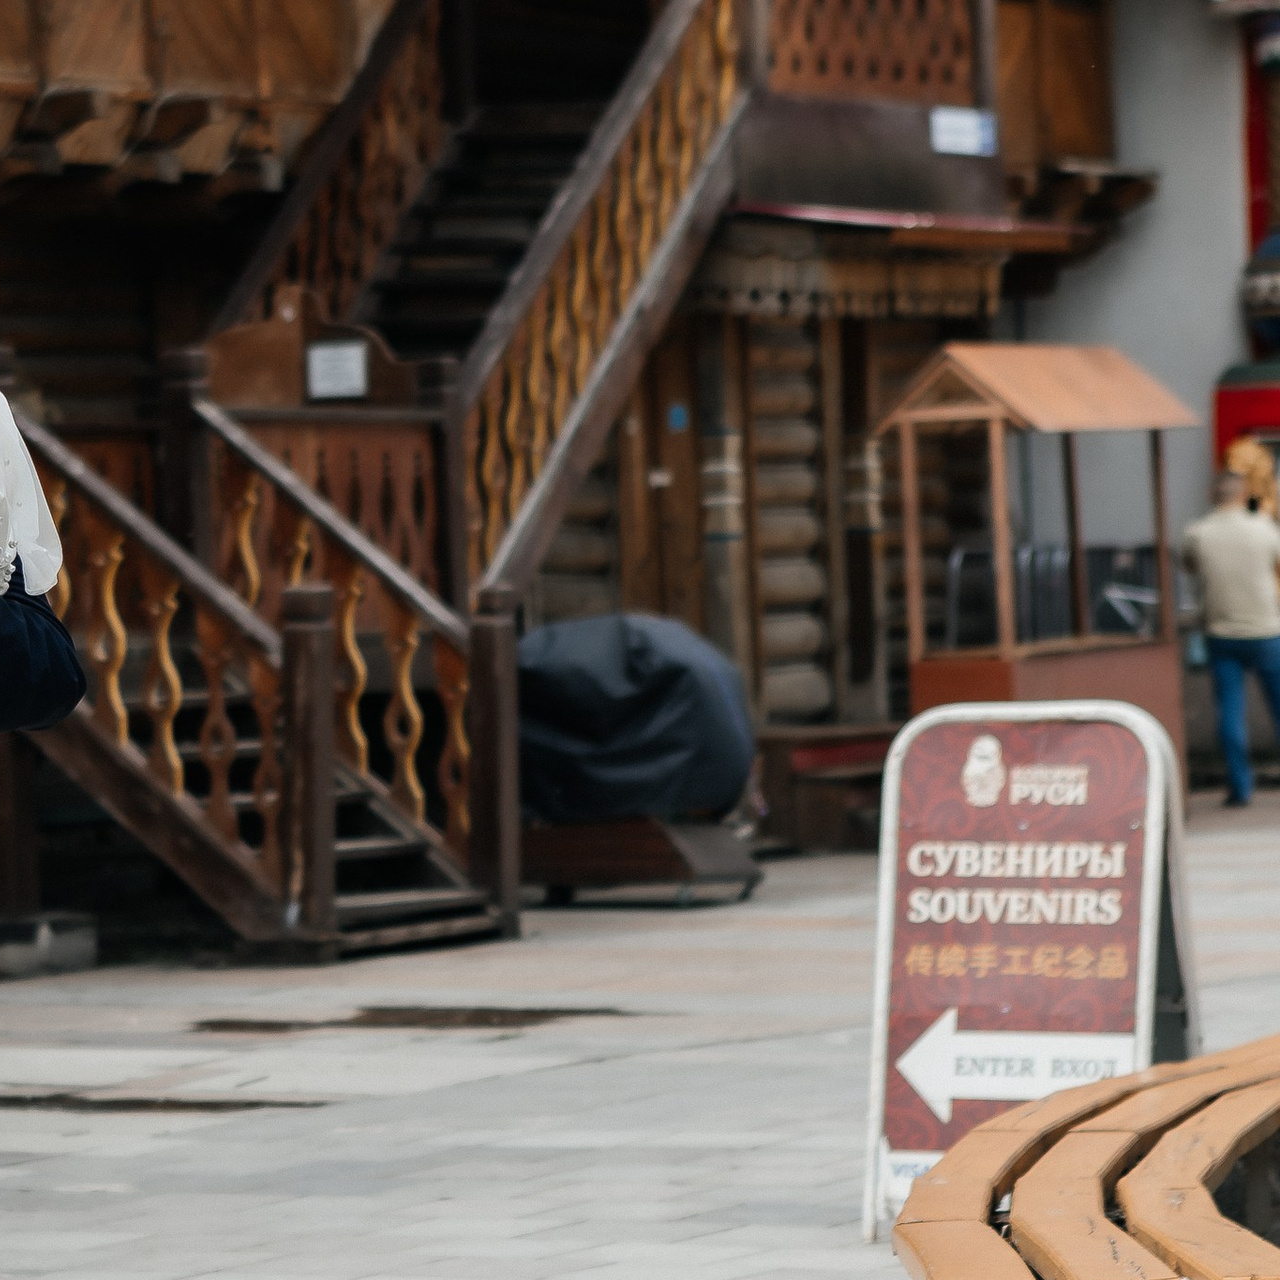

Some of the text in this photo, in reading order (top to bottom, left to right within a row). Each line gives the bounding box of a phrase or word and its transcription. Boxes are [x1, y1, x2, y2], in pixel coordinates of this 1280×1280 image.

[1009, 782, 1088, 805] РУСИ
[907, 841, 1127, 878] СУВЕНИРЫ
[907, 887, 1123, 925] SOUVENIRS
[955, 1057, 1118, 1080] ENTER ВХОД
